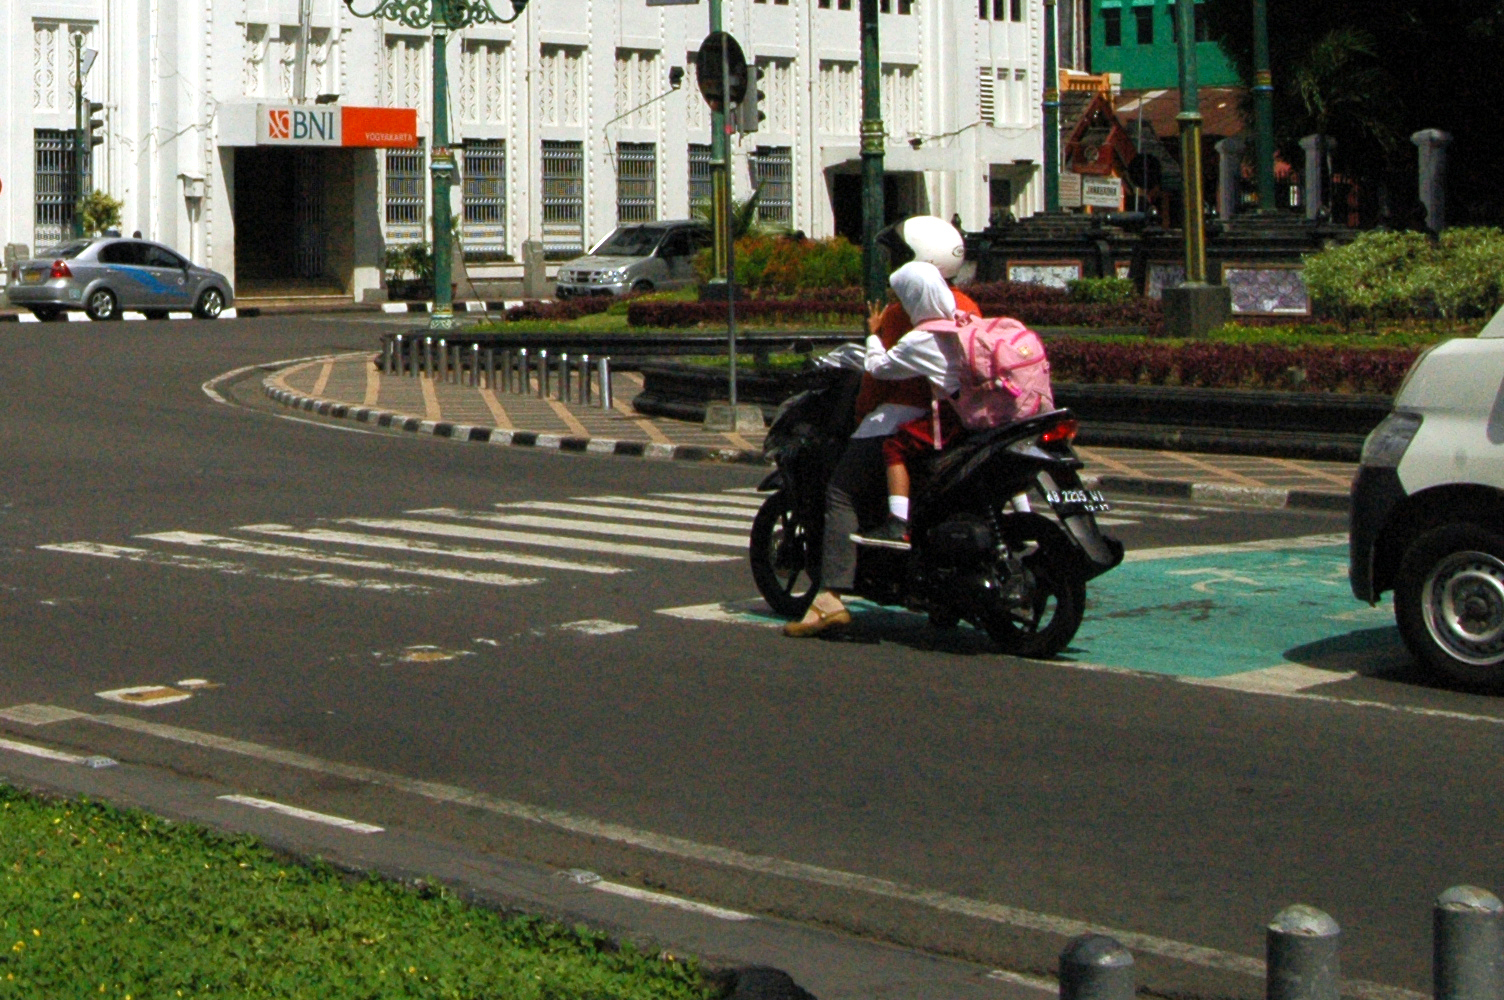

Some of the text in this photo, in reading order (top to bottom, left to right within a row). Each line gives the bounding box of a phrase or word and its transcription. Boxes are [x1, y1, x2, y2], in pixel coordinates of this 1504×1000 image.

[293, 110, 334, 140] BNI
[364, 132, 413, 142] YOGYAKARTA
[1046, 489, 1060, 503] AB
